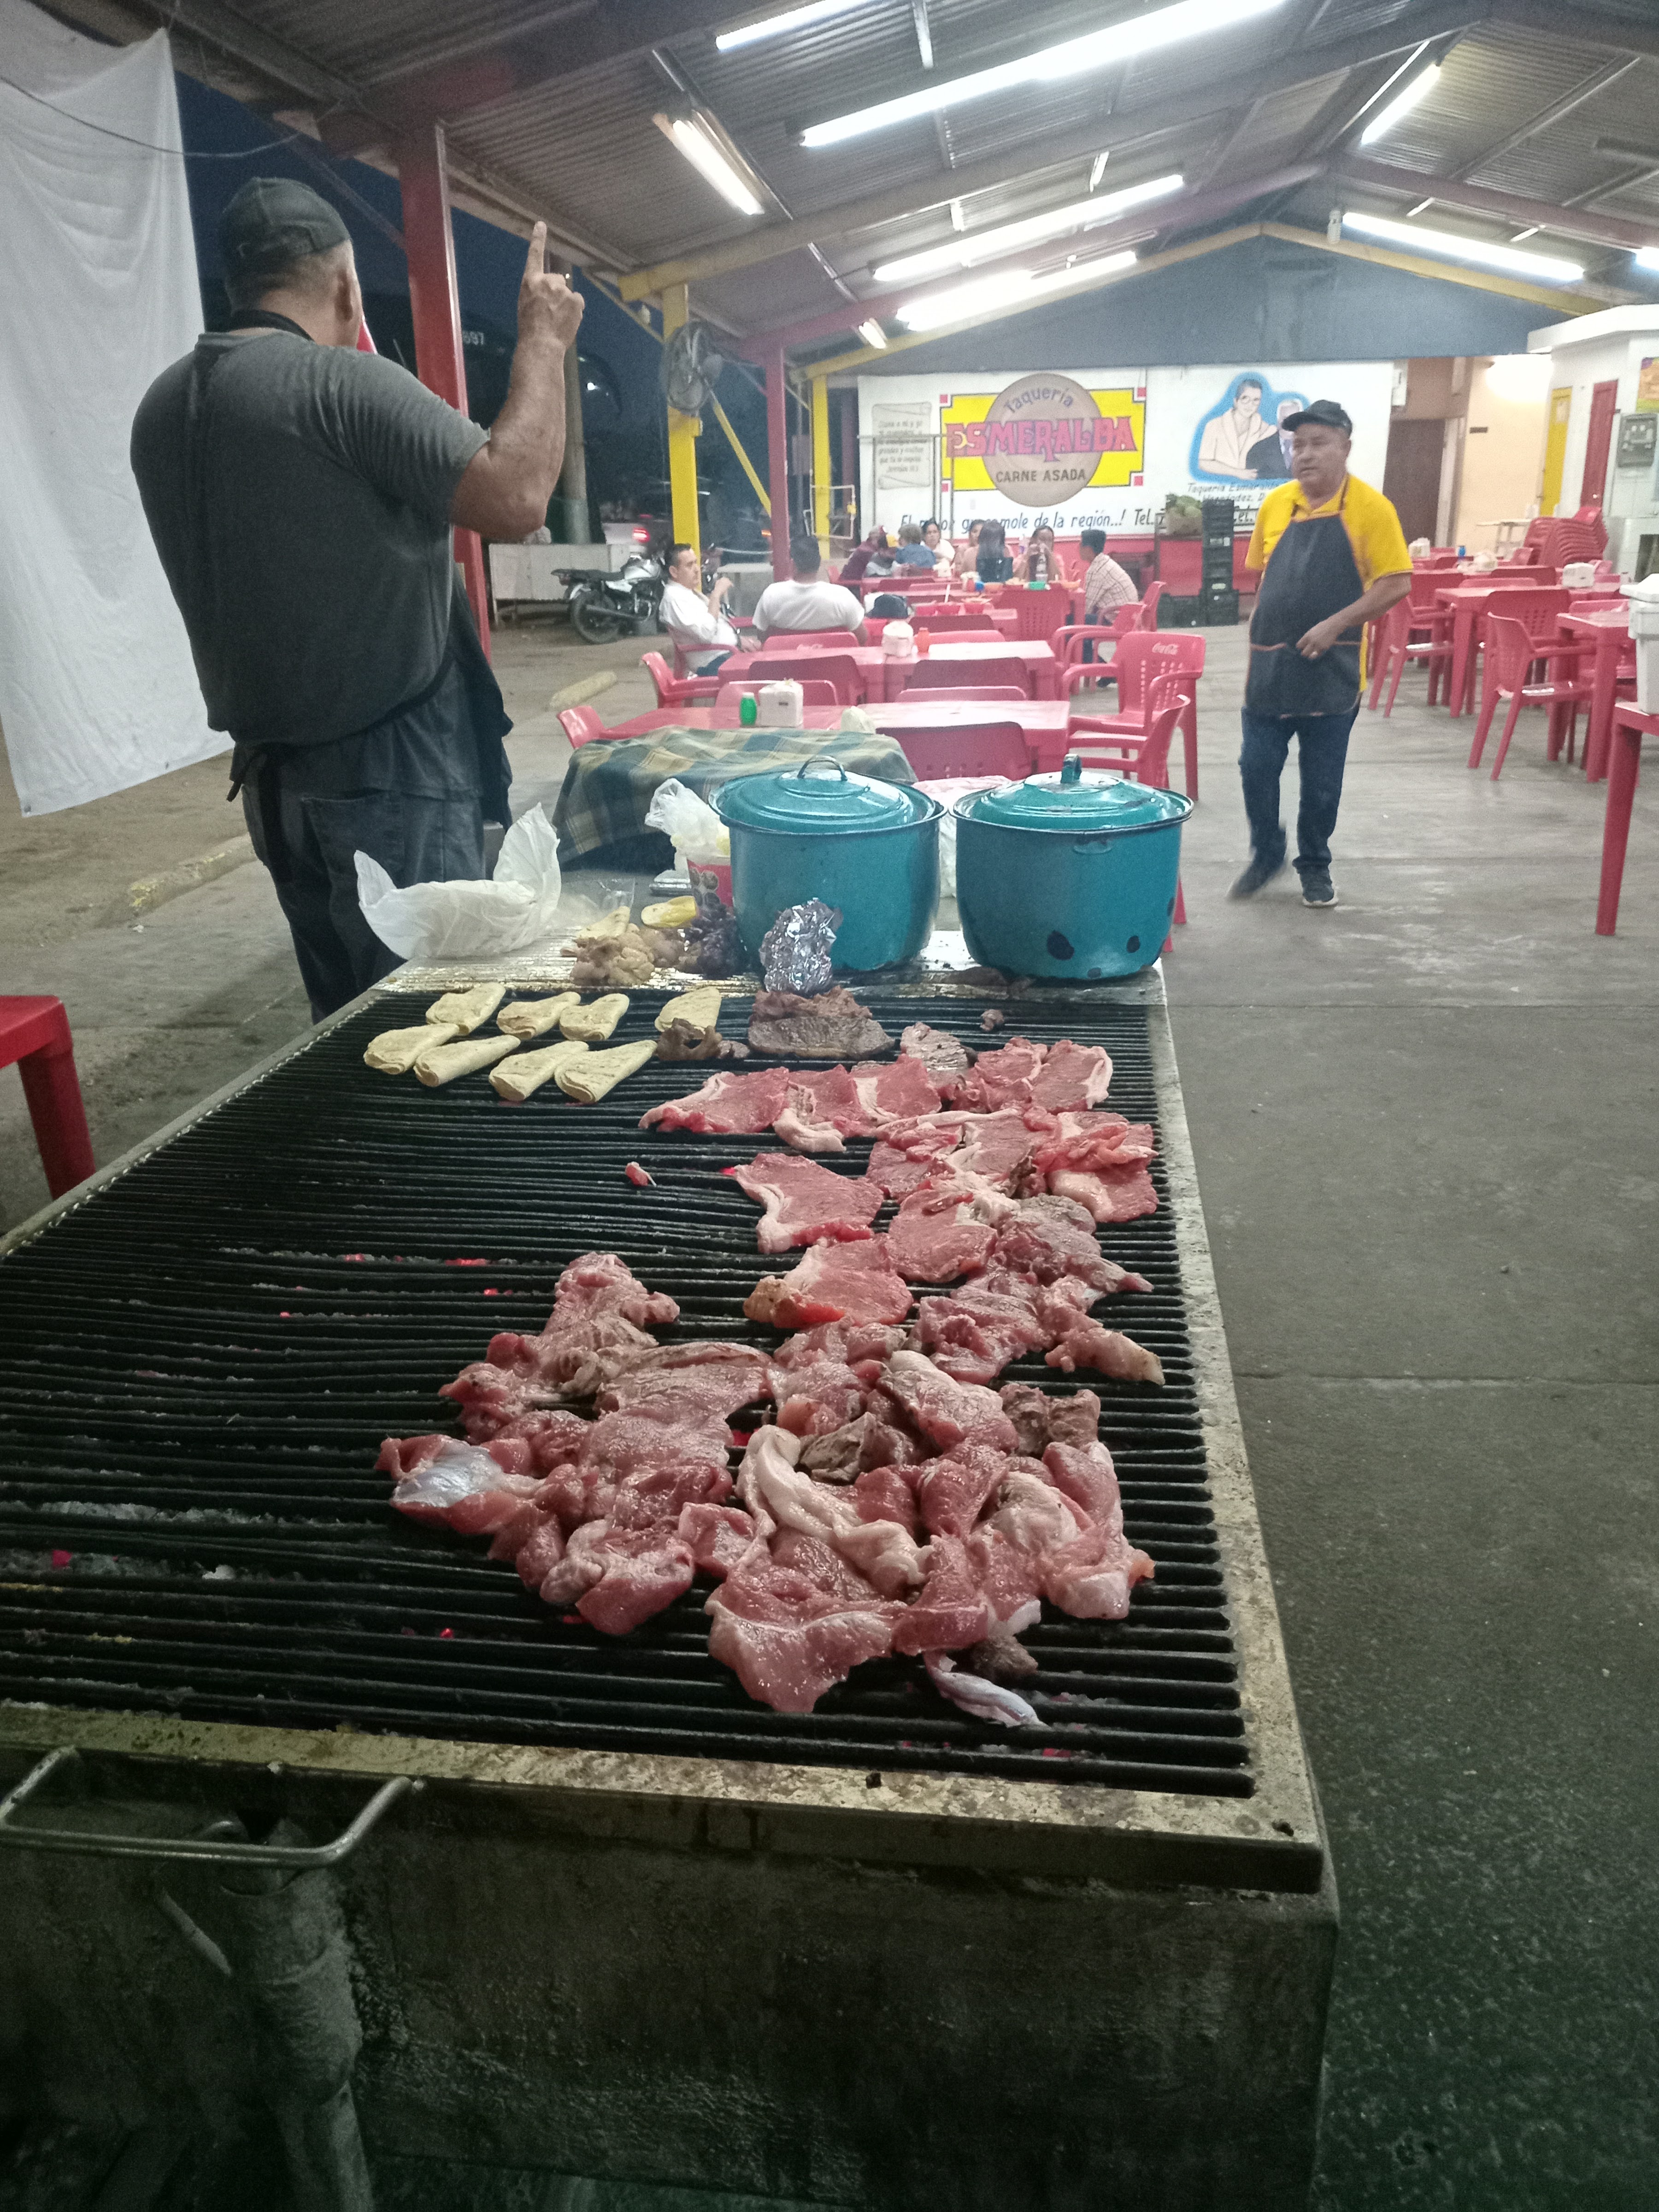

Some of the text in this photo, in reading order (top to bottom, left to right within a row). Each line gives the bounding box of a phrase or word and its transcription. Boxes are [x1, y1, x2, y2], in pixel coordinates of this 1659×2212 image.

[1004, 388, 1073, 413] Taquería
[945, 416, 1137, 462] ESMERALDA
[995, 469, 1086, 483] CARNE ASADA
[1053, 512, 1064, 528] la
[1134, 508, 1153, 525] Tel.
